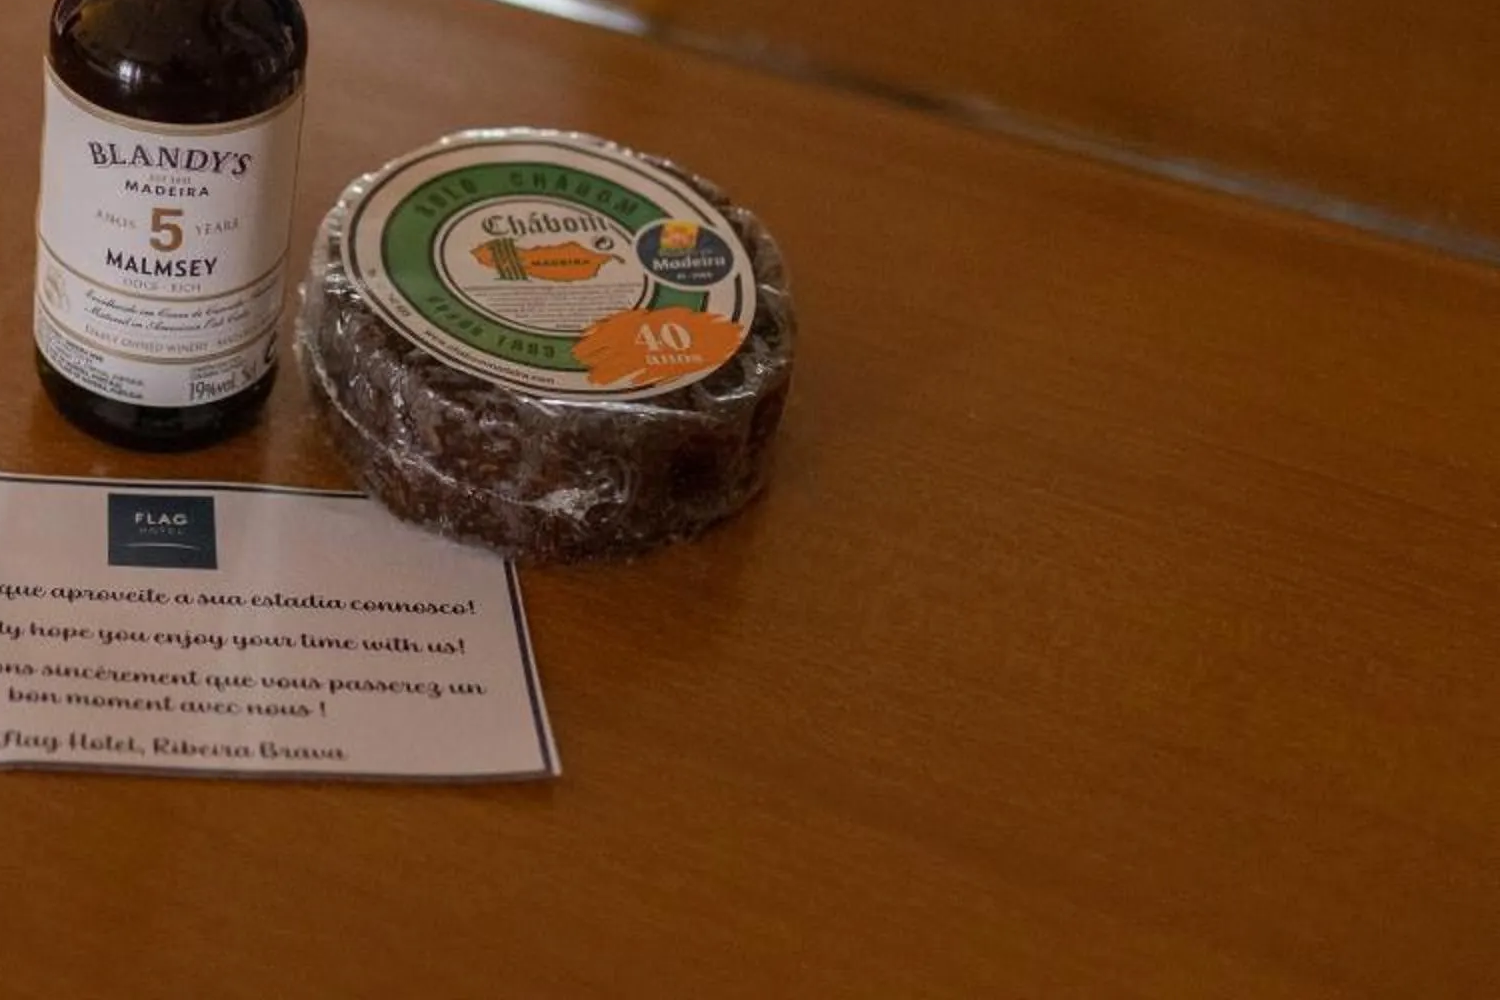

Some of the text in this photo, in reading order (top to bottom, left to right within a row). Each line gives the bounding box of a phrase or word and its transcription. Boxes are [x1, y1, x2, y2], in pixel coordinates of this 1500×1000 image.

[88, 141, 254, 176] BLANDY'S
[125, 180, 210, 197] MADEIRA
[149, 208, 184, 252] 5
[106, 248, 218, 277] MALMSEY
[652, 253, 727, 271] Madeira
[634, 322, 692, 351] 40
[134, 511, 189, 526] FLAG
[51, 585, 170, 605] aproveite
[174, 594, 192, 605] a
[197, 594, 244, 606] sua
[251, 592, 346, 611] estadia
[350, 598, 477, 615] connosco!
[29, 622, 93, 642] hope
[98, 627, 152, 646] you
[153, 630, 228, 650] enjoy
[232, 635, 297, 651] your
[300, 633, 355, 651] time
[362, 638, 422, 654] with
[427, 638, 466, 655] us!
[206, 674, 256, 692] que
[262, 676, 321, 690] vous
[329, 678, 442, 697] passerez
[449, 683, 487, 695] un
[7, 686, 65, 703] bon
[66, 692, 175, 712] moment
[180, 702, 240, 714] avec
[247, 703, 314, 718] nous
